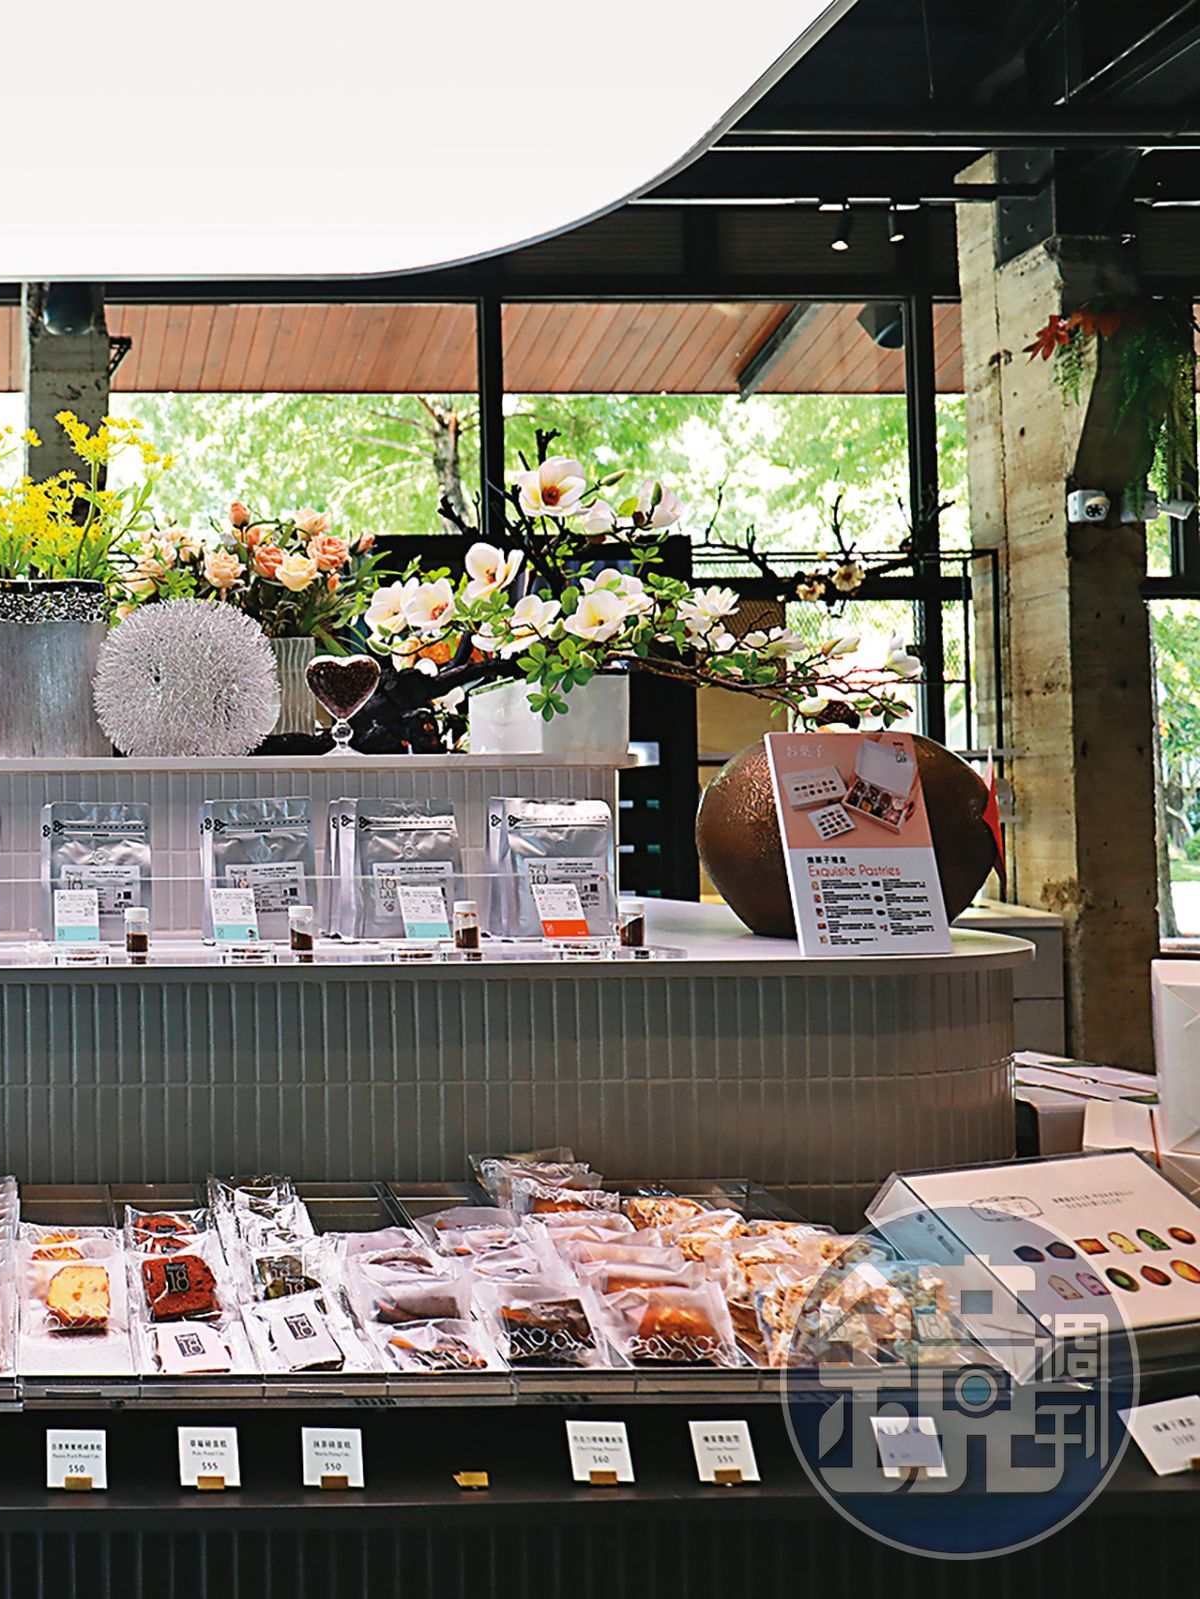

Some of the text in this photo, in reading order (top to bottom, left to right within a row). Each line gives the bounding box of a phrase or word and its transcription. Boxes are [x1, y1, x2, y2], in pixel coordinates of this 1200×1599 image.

[808, 864, 901, 877] Exquisite Pastries
[167, 1271, 189, 1293] 18
[290, 1320, 315, 1338] 18
[179, 1338, 204, 1356] 18
[69, 1464, 85, 1473] $50
[202, 1462, 218, 1470] $55
[325, 1462, 341, 1471] $50
